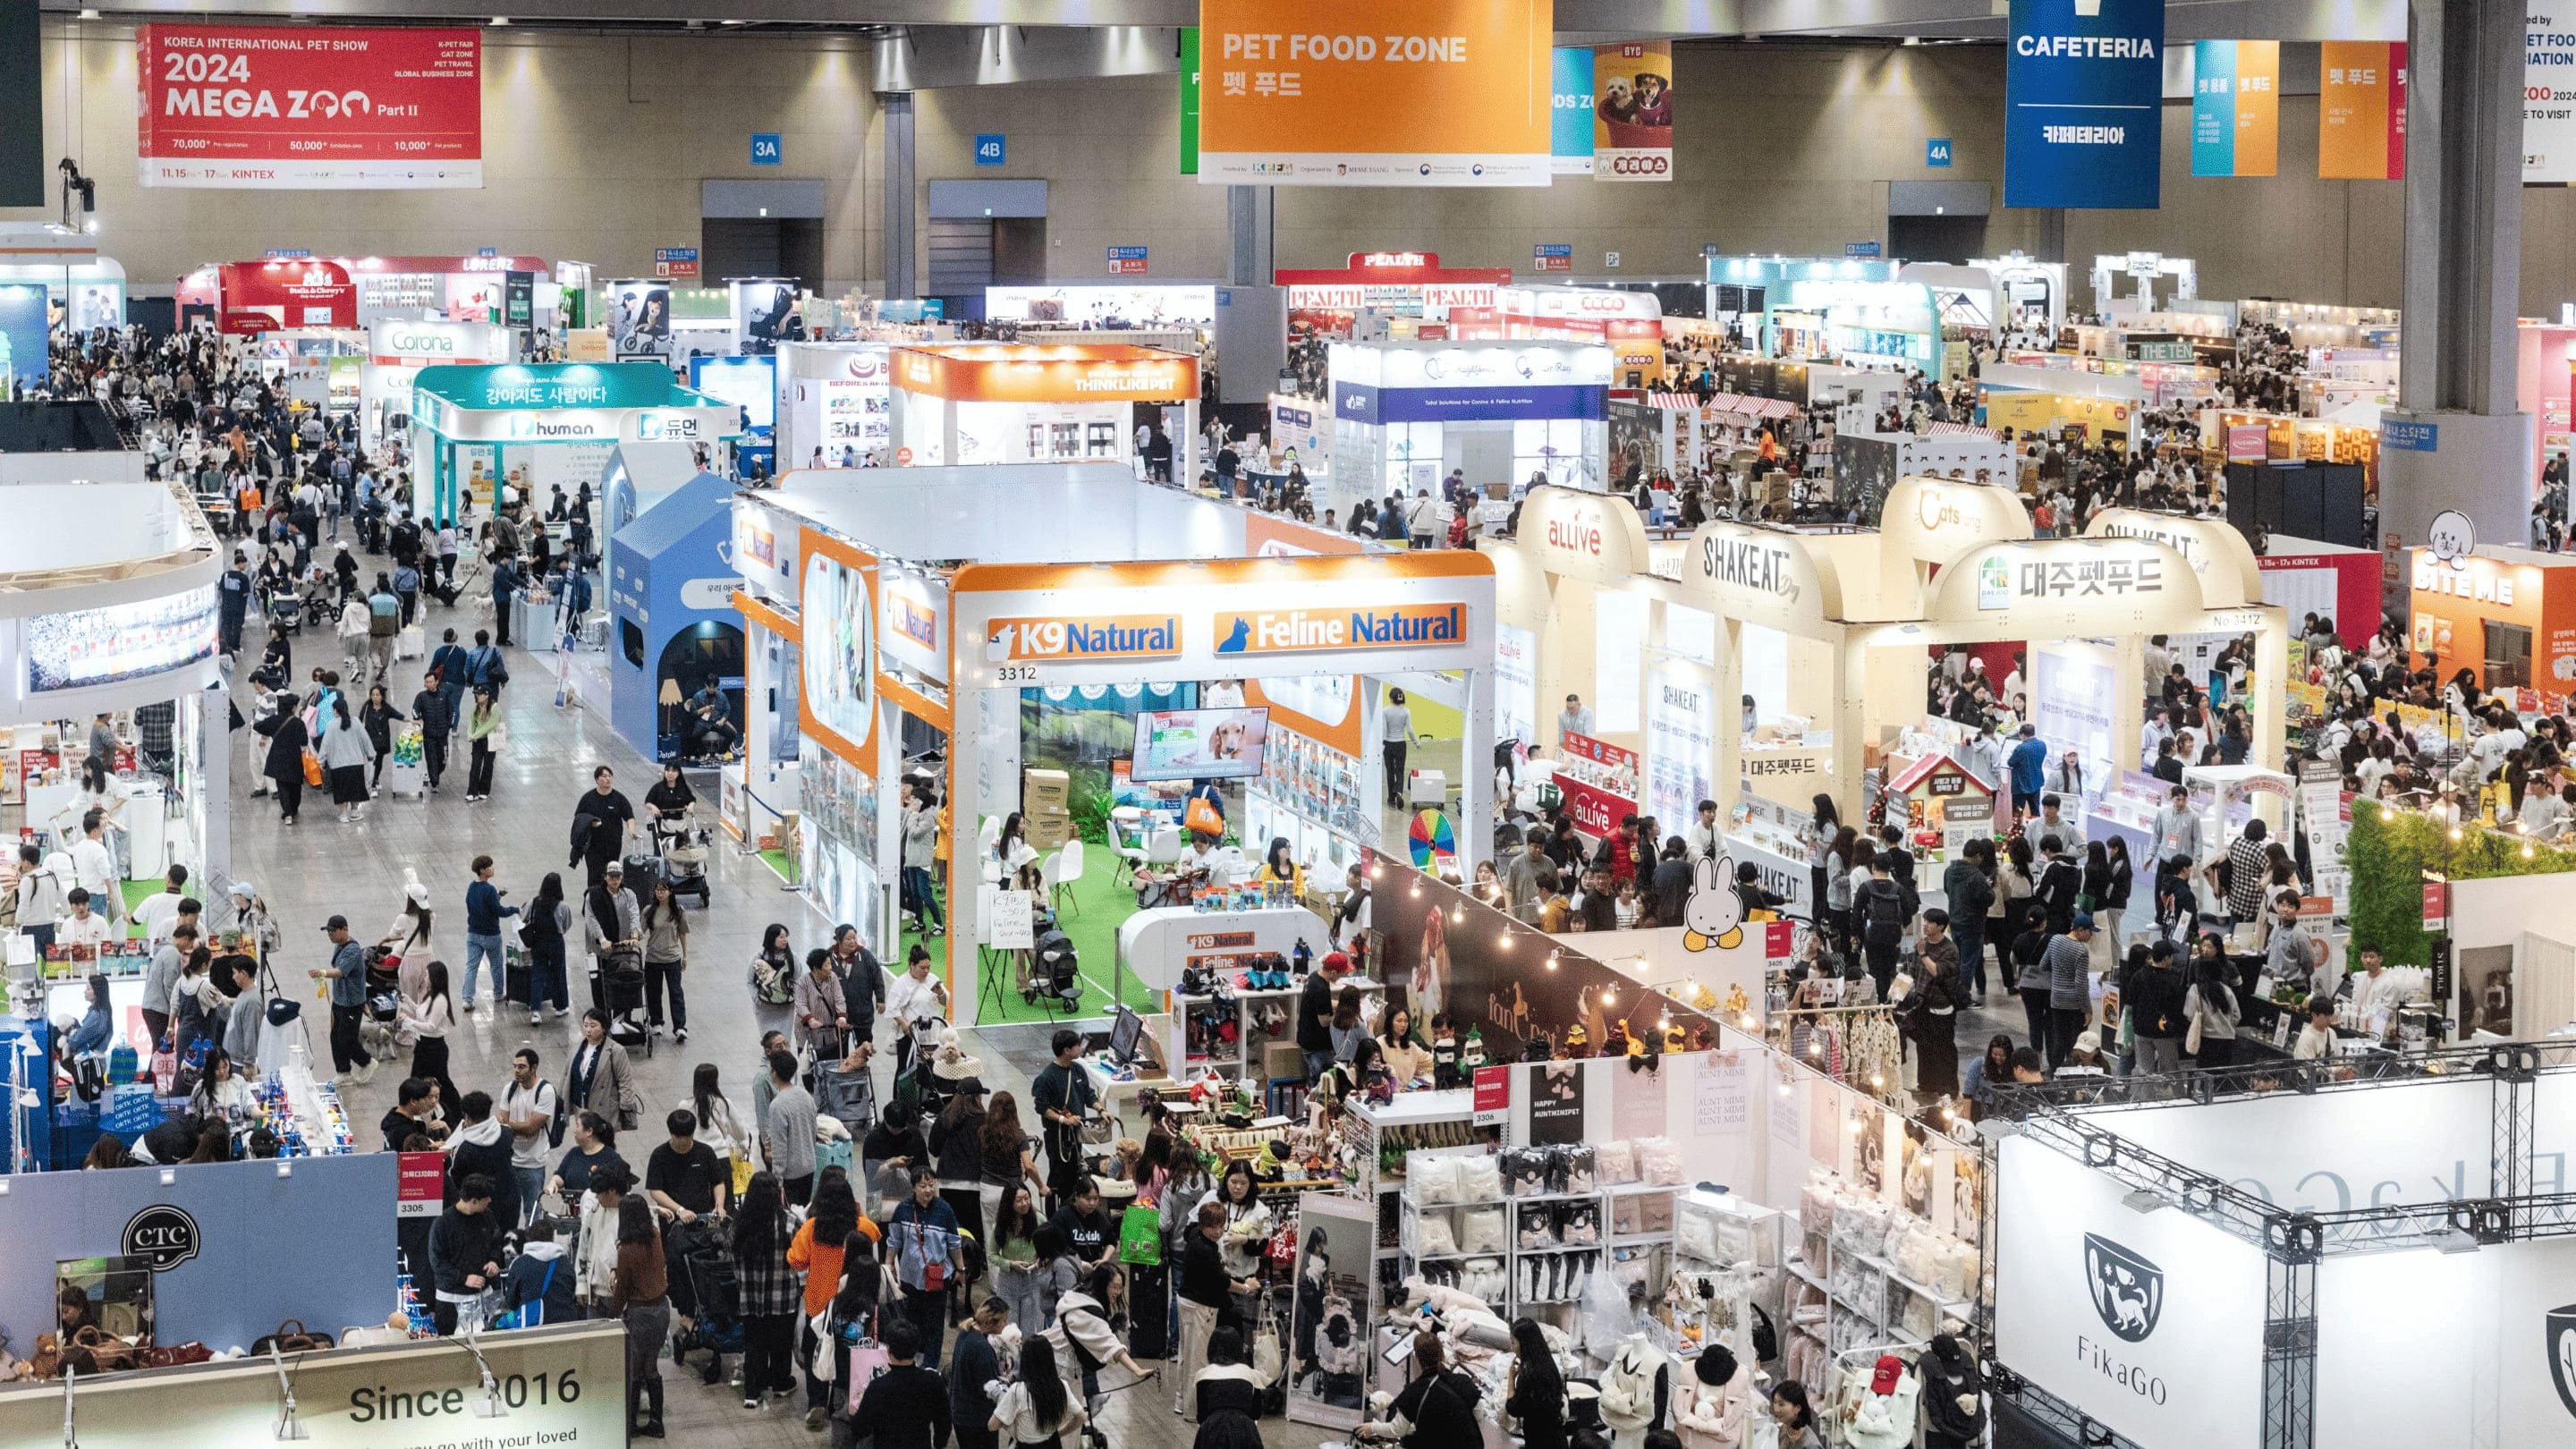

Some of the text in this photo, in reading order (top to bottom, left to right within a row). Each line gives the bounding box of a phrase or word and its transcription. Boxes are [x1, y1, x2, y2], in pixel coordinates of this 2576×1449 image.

[2526, 15, 2552, 27] ed by
[164, 37, 369, 51] KOREA INTERNATIONAL PET SHOW
[2017, 35, 2155, 58] CAFETERIA
[2527, 34, 2576, 47] ET FOO
[1224, 34, 1467, 63] PET FOOD ZONE
[1624, 47, 1641, 56] BYC
[2525, 53, 2573, 65] IATION
[165, 53, 250, 82] 2024
[1224, 72, 1302, 97] 펫 푸드
[2329, 69, 2376, 85] 펫 푸드
[165, 88, 280, 118] MEGA
[1552, 94, 1576, 108] DS
[377, 103, 405, 116] Part
[2530, 110, 2572, 119] TO VISIT
[2043, 126, 2125, 145] 카페테리아
[756, 142, 776, 157] 3A
[979, 142, 1000, 157] 4B
[1930, 147, 1949, 159] 4A
[232, 169, 275, 180] KINTEX
[462, 258, 513, 271] LORENZ
[1364, 254, 1425, 267] PEALTH
[1292, 290, 1361, 307] PEALTH
[1426, 289, 1494, 306] PEALTH
[393, 331, 453, 352] Corona
[2140, 344, 2166, 359] THE
[2170, 343, 2192, 358] TEN
[1074, 377, 1174, 392] THINK LIKE PET
[487, 386, 607, 404] 강아지도 사람이다
[666, 418, 697, 438] 듀먼
[1703, 536, 1780, 593] SHAKEAT
[2292, 558, 2319, 566] KINTEX
[2021, 558, 2162, 597] 대주펫푸드
[708, 584, 721, 593] 우리
[2476, 576, 2514, 606] ME
[1257, 606, 1458, 648] Feline Natural
[998, 667, 1036, 681] 3312
[1664, 685, 1698, 713] SHAKEAT
[1751, 758, 1815, 776] 대주펫푸드
[1756, 863, 1799, 904] HAKEAT
[1697, 1068, 1746, 1080] AUNT MIMI
[1534, 1099, 1556, 1107] HAPPY
[1697, 1096, 1746, 1108] AUNT MIMI
[1476, 1114, 1495, 1122] 3306
[1534, 1108, 1580, 1118] AUNTMIMIPET
[1697, 1105, 1746, 1117] AUNT MIMI
[1697, 1114, 1746, 1126] AUNT MIMI
[402, 1204, 424, 1213] 3305
[135, 1225, 187, 1248] CTC
[350, 1386, 463, 1423] Since
[462, 1427, 577, 1449] with your loved
